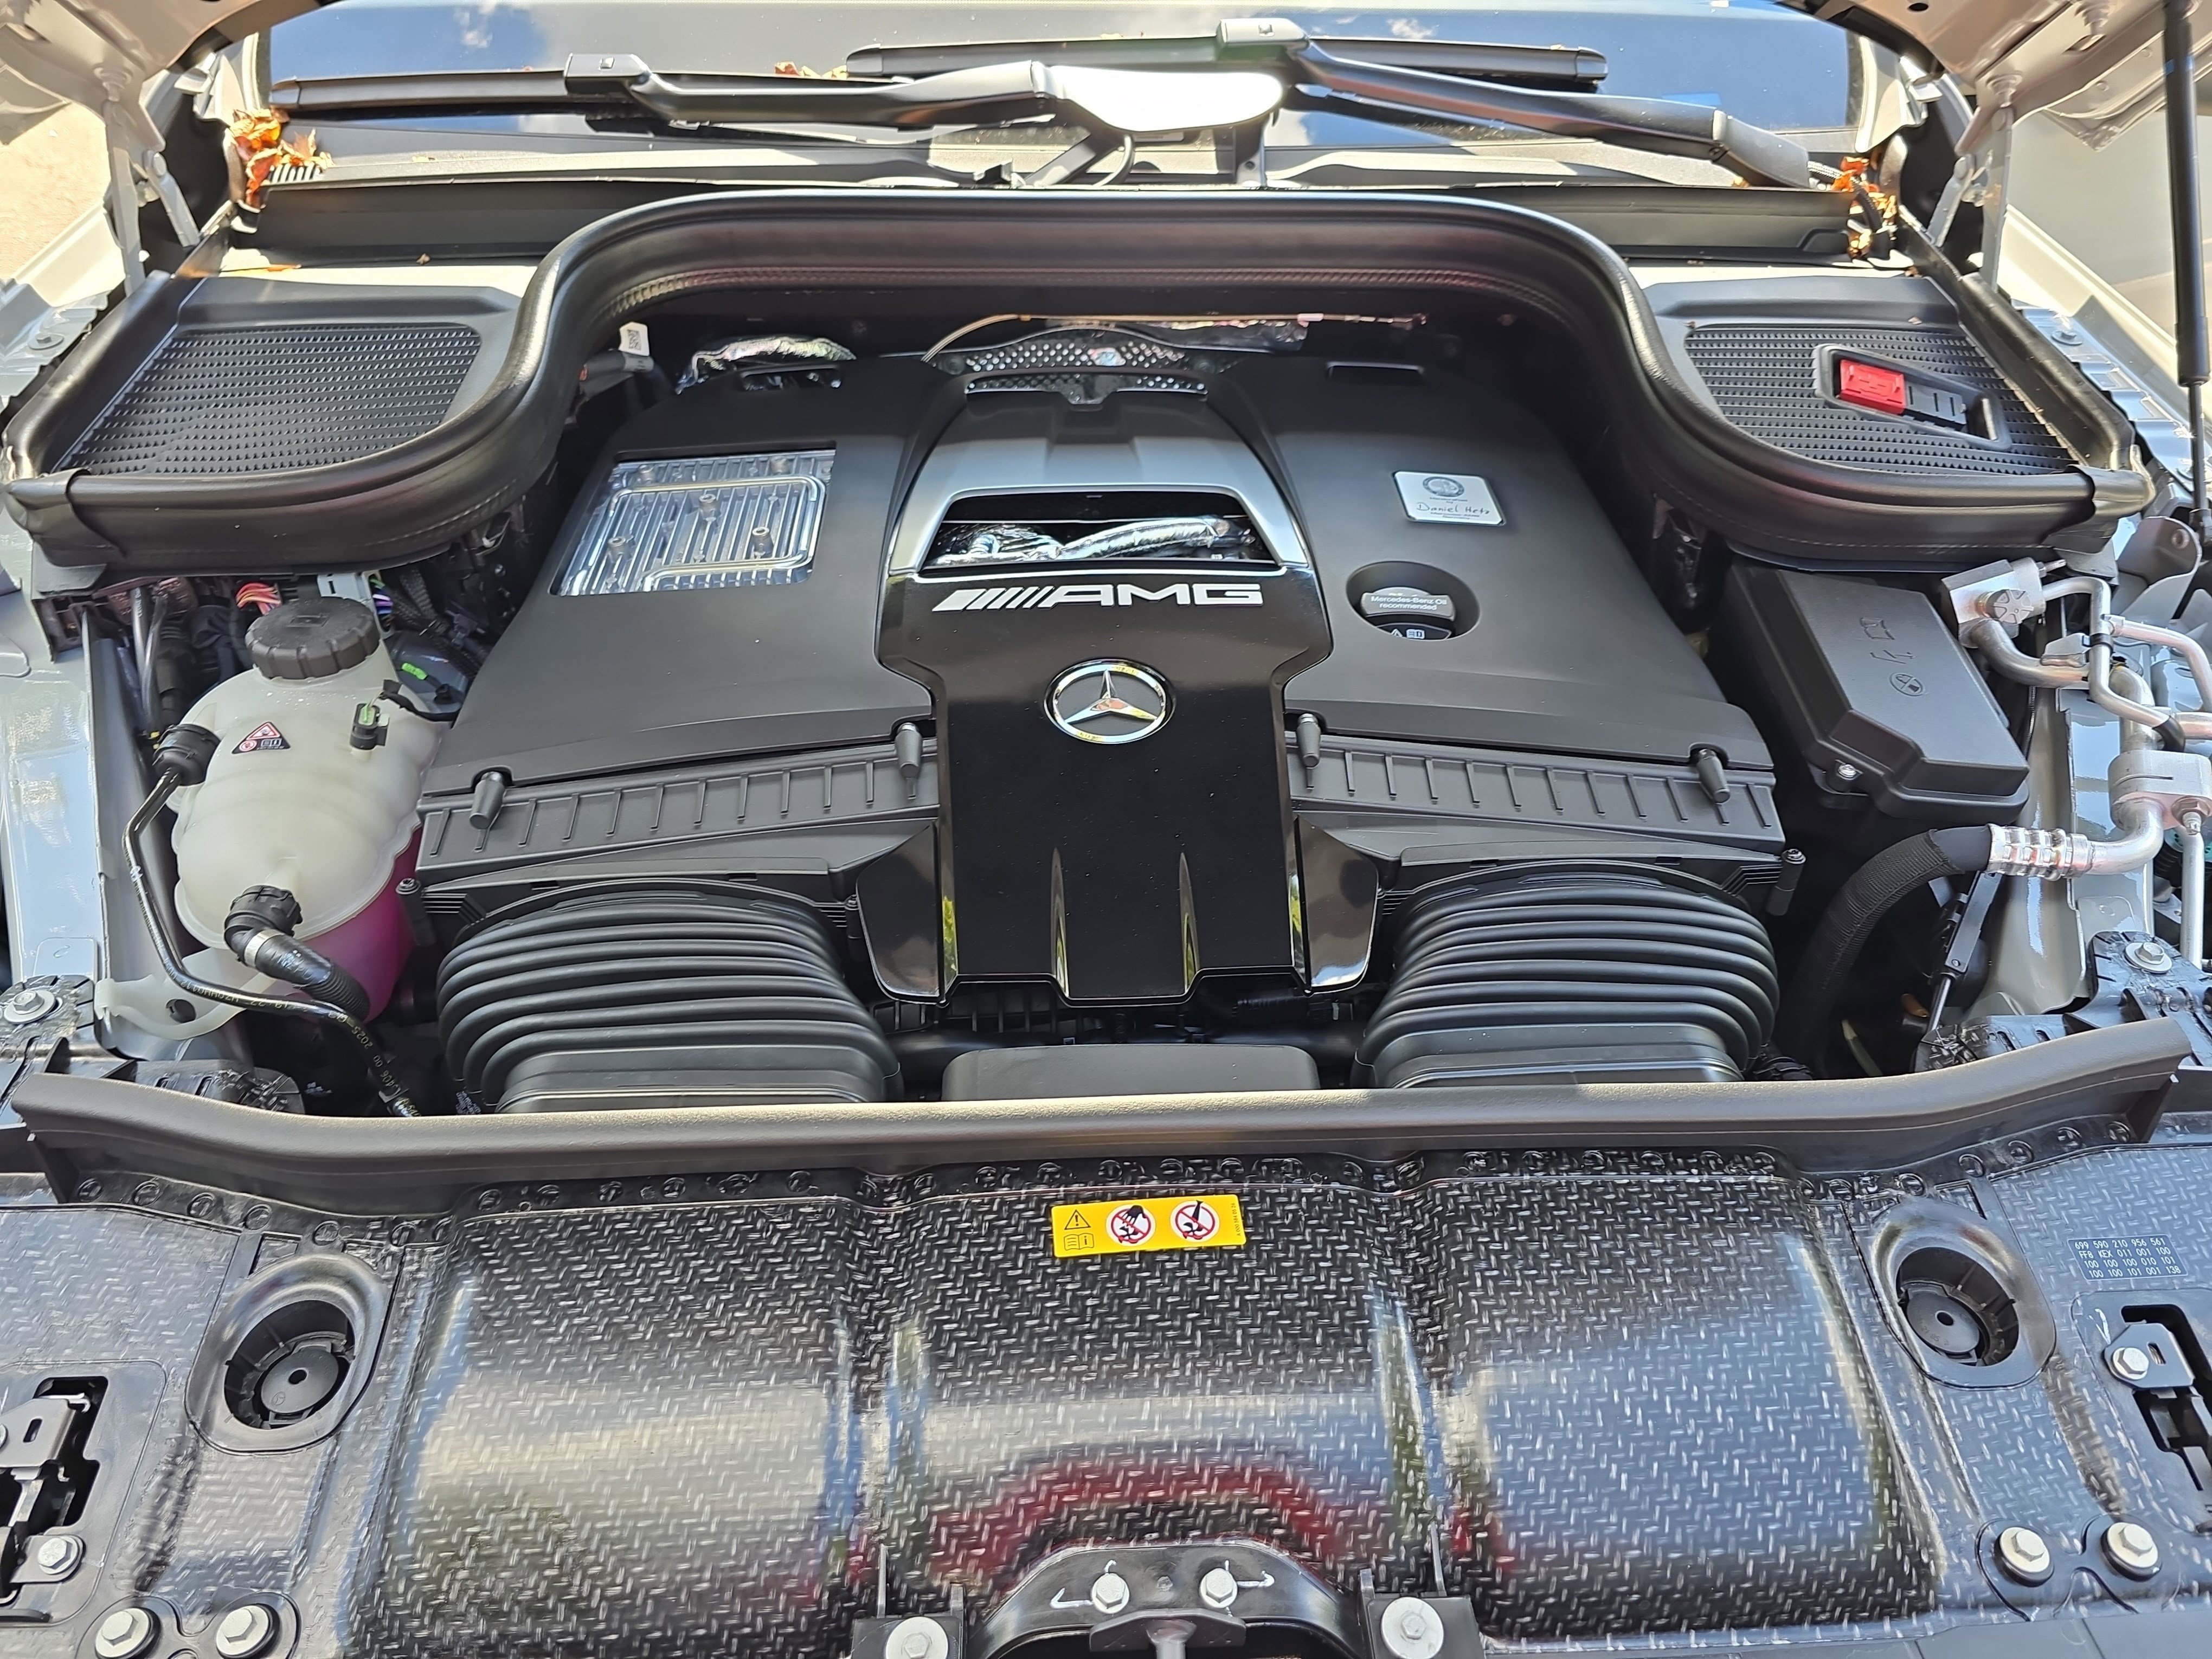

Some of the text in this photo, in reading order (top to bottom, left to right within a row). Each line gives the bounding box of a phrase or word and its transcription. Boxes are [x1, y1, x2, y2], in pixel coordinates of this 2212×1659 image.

[1416, 502, 1458, 513] Daniel
[1038, 584, 1264, 608] AMG
[1371, 596, 1434, 605] Mercedes-Benz
[352, 1026, 374, 1050] 2025
[2093, 1240, 2109, 1249] 590
[2131, 1238, 2147, 1246] 956
[2078, 1250, 2094, 1259] FF8
[2098, 1250, 2113, 1258] KEX
[2136, 1248, 2151, 1256] 001
[2156, 1246, 2171, 1255] 100
[2084, 1256, 2176, 1268] 100 100 100 010 101
[2088, 1265, 2181, 1278] 100 100 101 001 138
